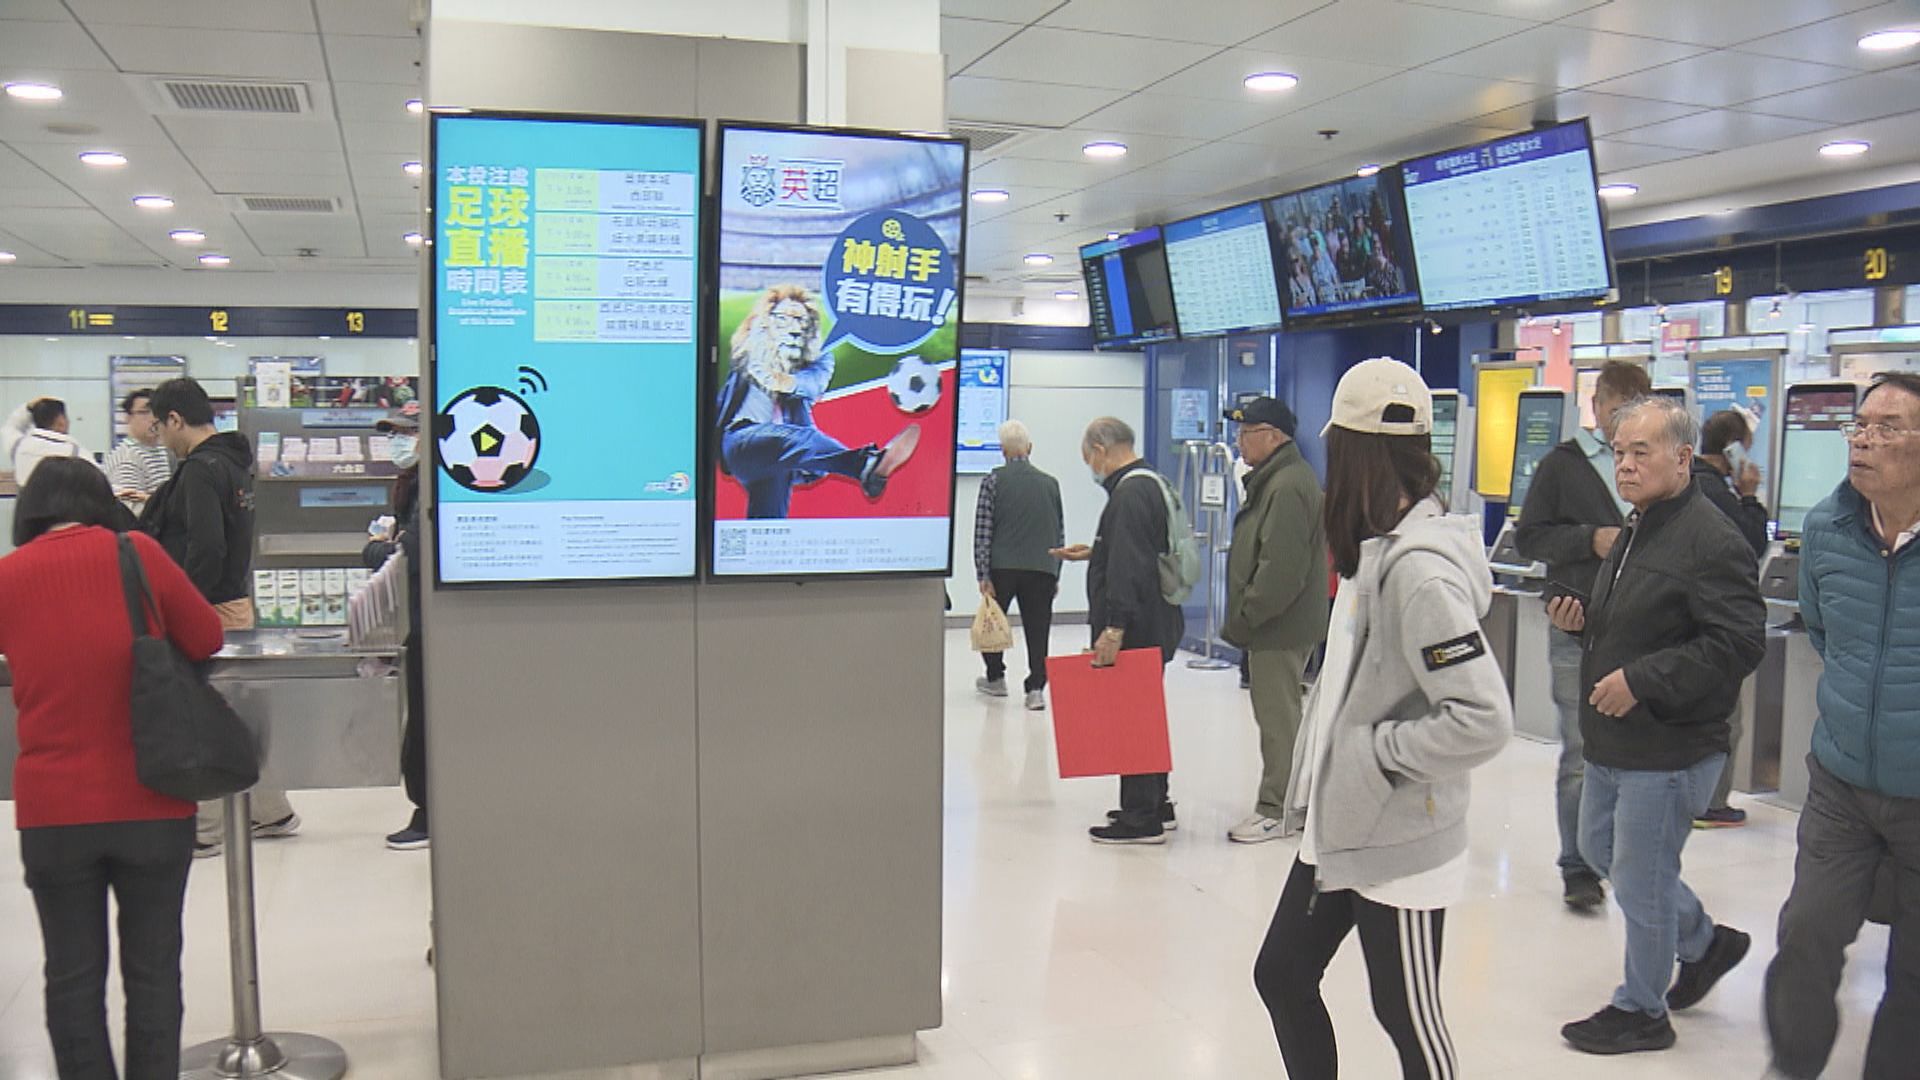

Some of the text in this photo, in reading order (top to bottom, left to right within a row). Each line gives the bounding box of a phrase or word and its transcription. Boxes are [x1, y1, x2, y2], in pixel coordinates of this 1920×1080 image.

[447, 166, 529, 186] 本投注處
[781, 168, 839, 202] 英超
[445, 186, 530, 226] 足球
[444, 229, 529, 267] 直播
[842, 238, 941, 282] 神射手
[1864, 248, 1888, 279] 20
[446, 269, 528, 294] 時間表
[1716, 266, 1733, 294] 19
[836, 278, 956, 325] 有得玩!
[69, 309, 87, 330] 11
[210, 311, 229, 331] 12
[346, 312, 365, 332] 13
